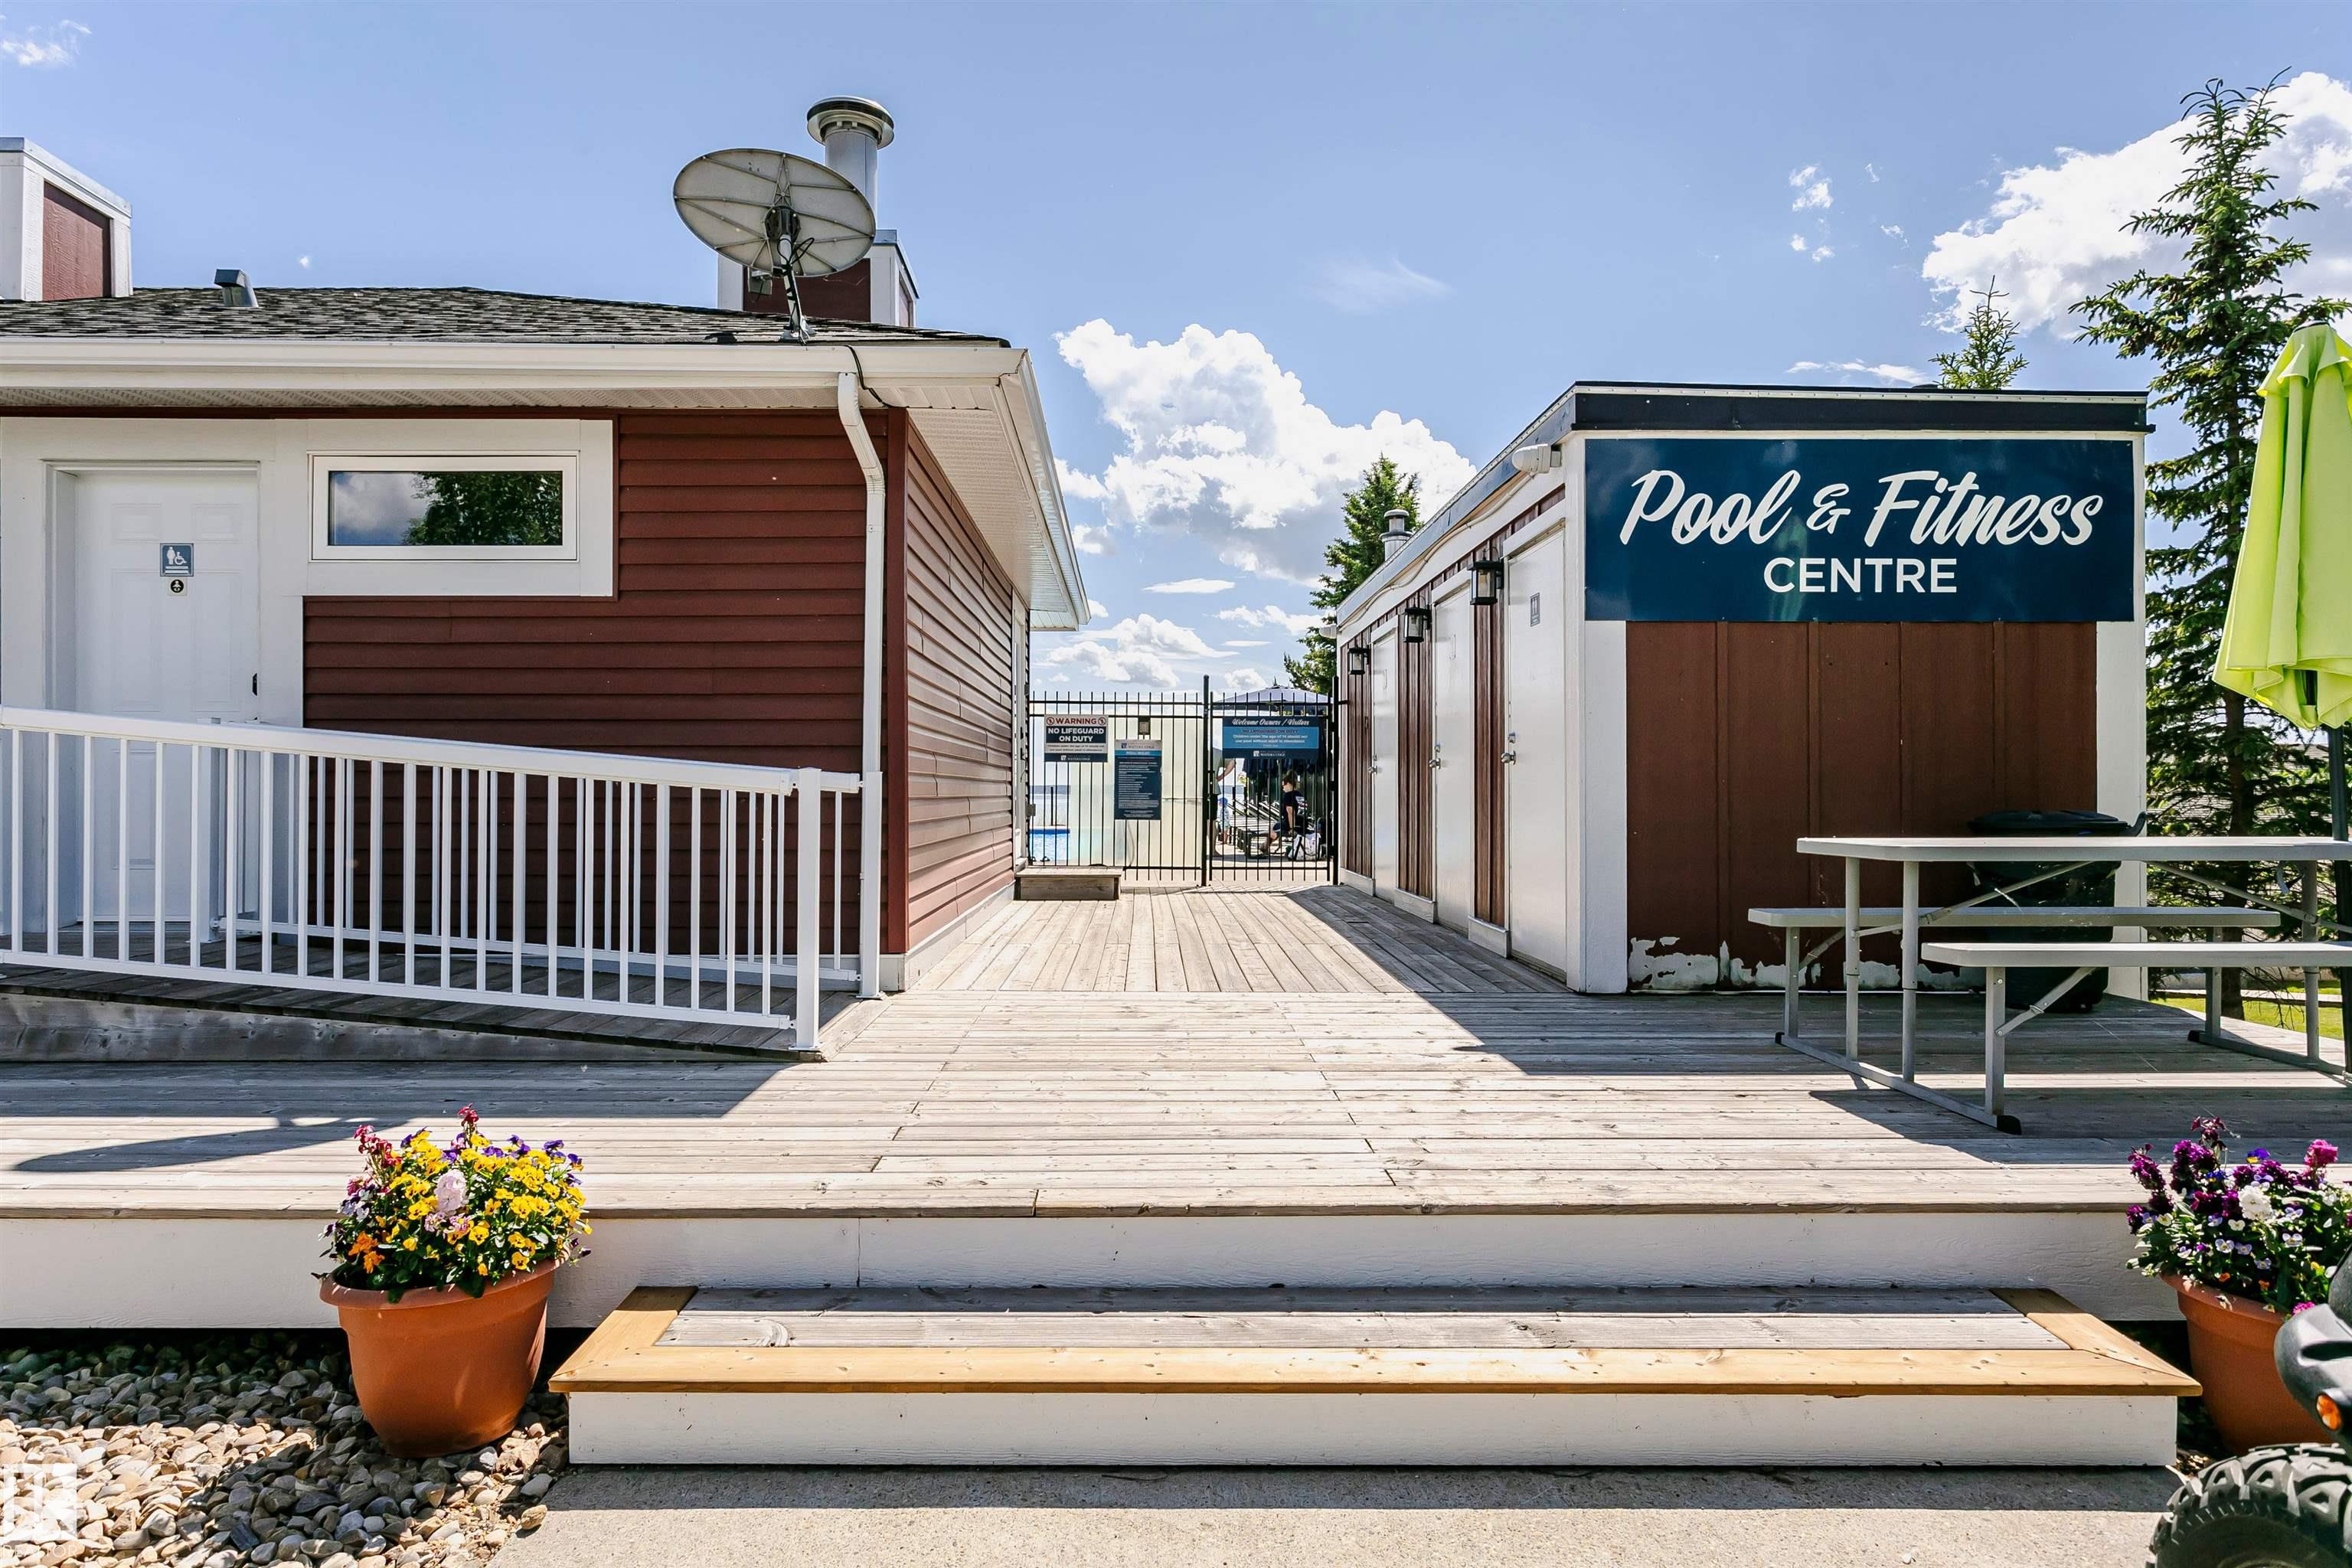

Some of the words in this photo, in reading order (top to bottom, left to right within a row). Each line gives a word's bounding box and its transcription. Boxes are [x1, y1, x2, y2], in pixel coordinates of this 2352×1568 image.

[1619, 469, 1802, 545] Pool
[1806, 483, 1851, 534] &
[1864, 469, 2104, 547] Fitness
[1763, 557, 1958, 593] CENTRE
